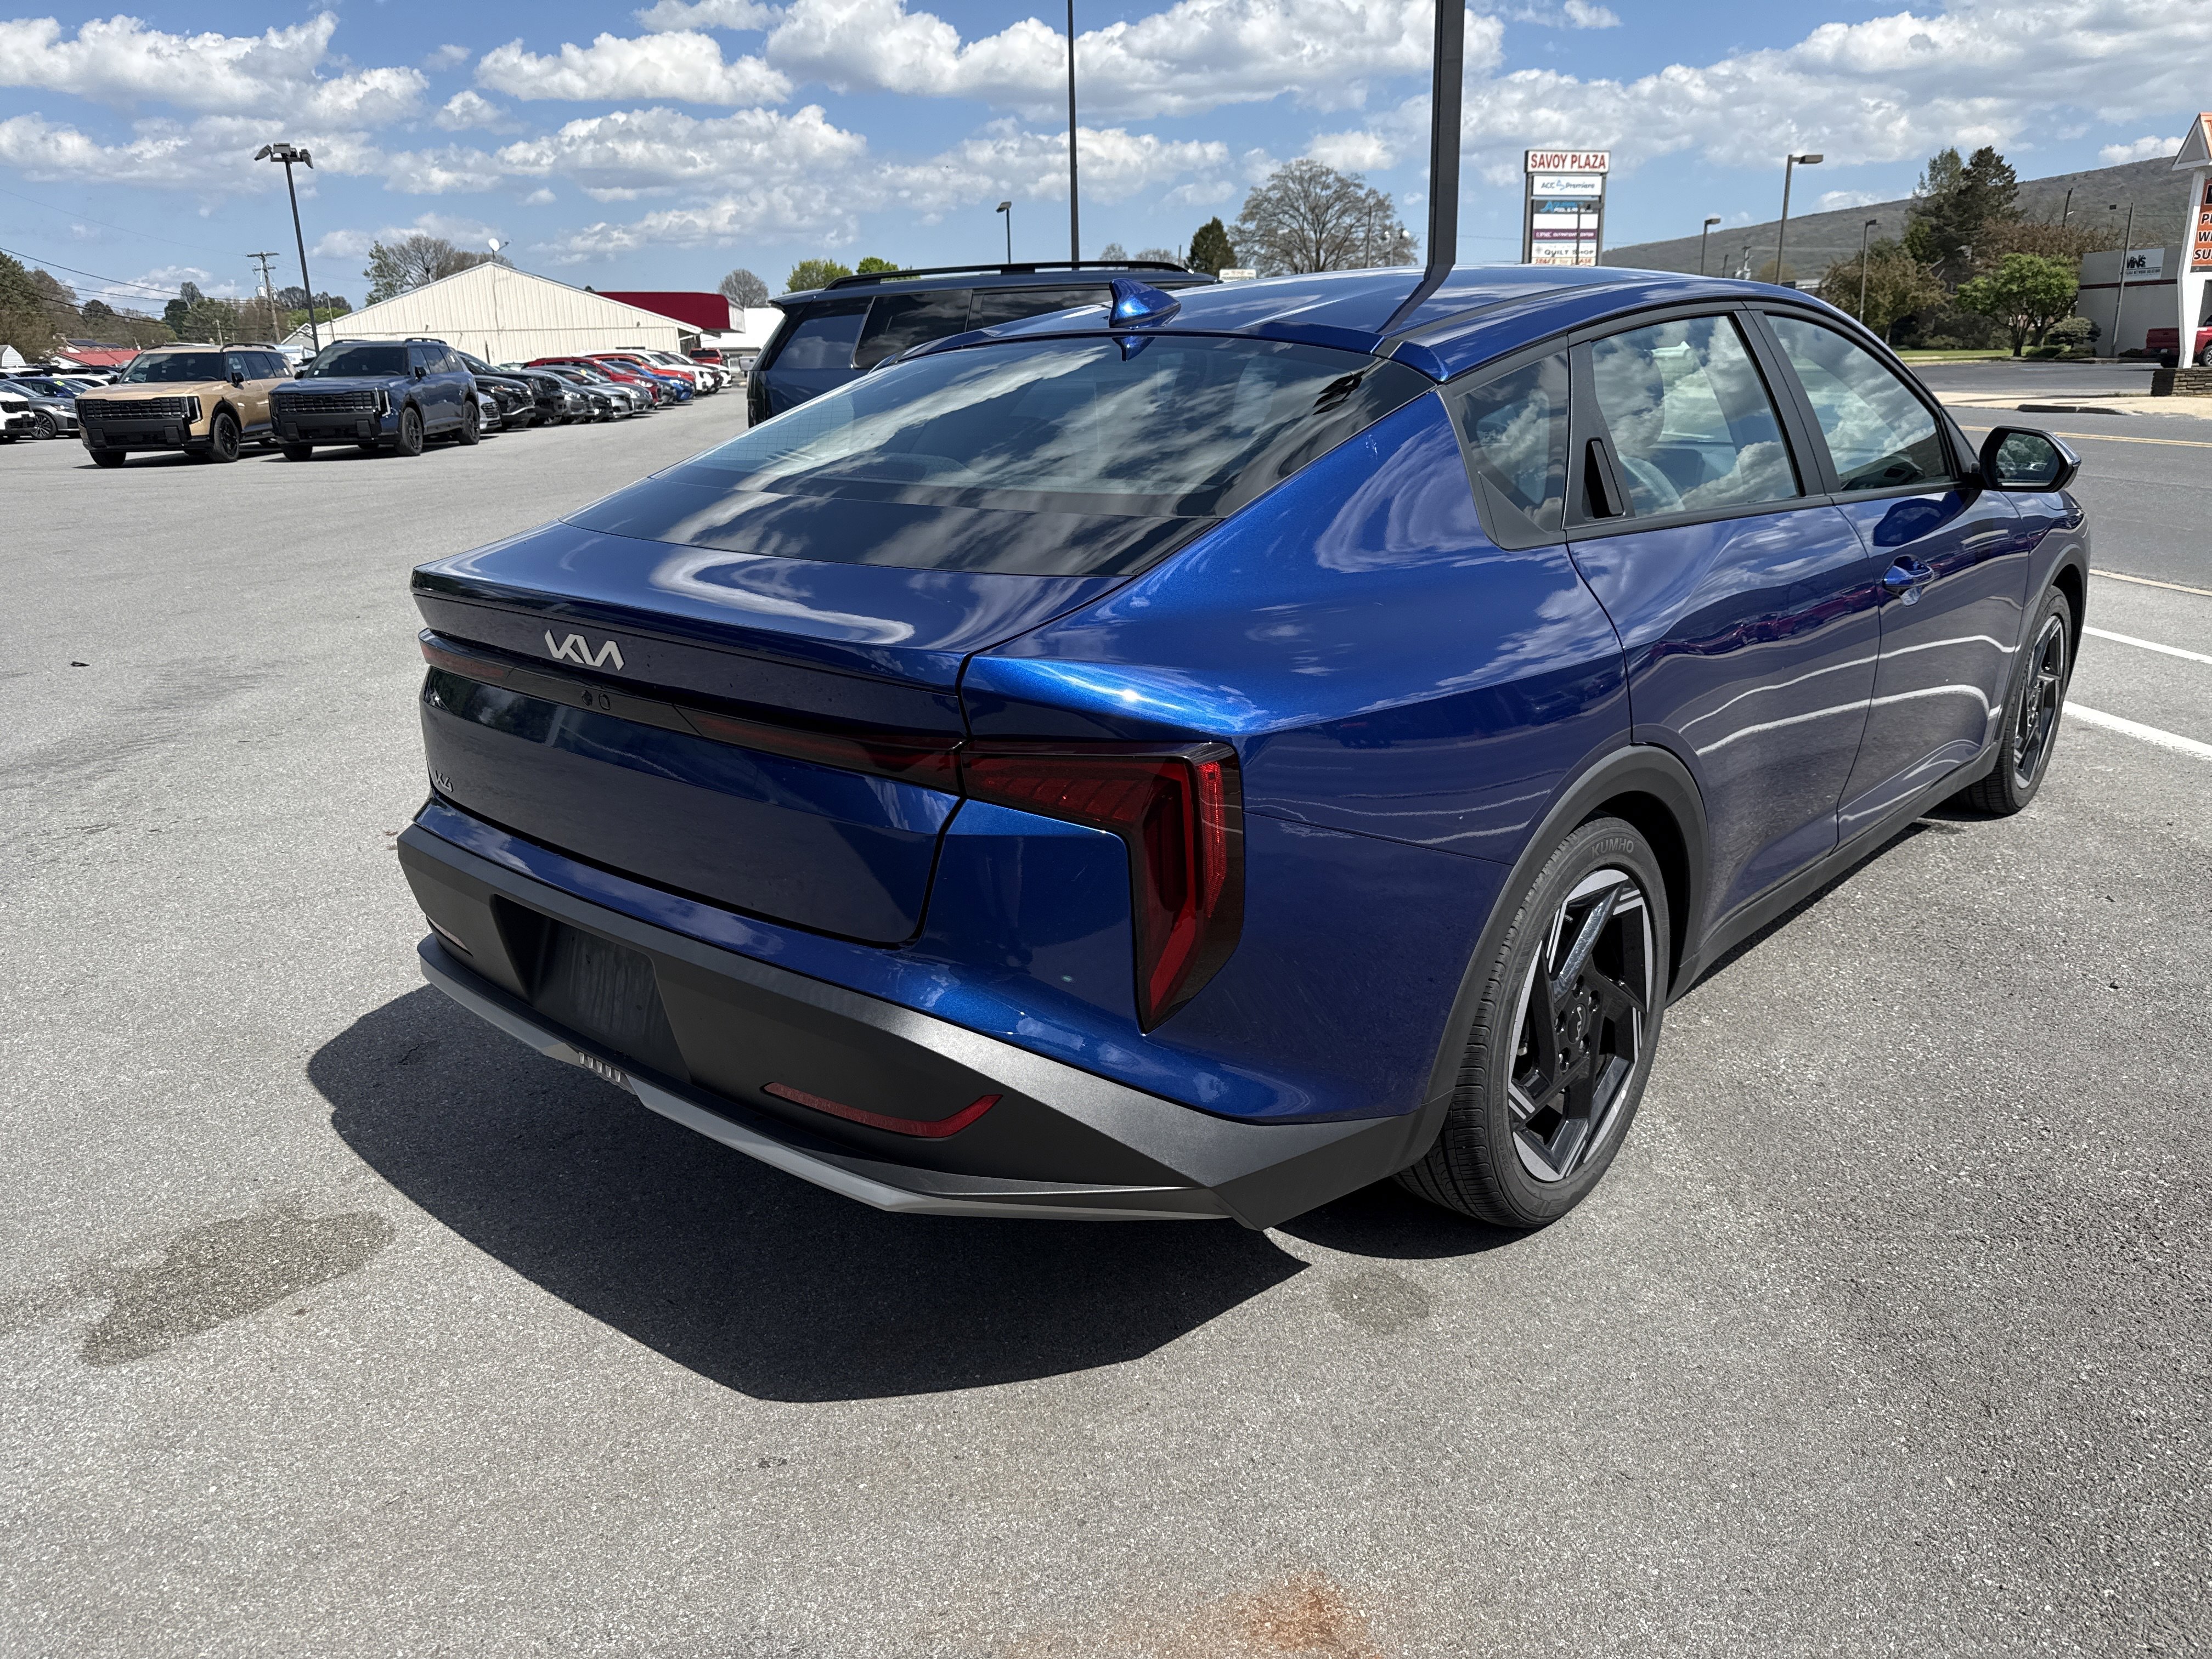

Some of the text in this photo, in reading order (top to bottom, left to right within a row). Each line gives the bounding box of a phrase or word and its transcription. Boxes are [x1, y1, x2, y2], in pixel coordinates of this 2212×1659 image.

[1531, 154, 1606, 169] SAVOY PLAZA
[2194, 249, 2212, 259] SU
[544, 629, 625, 671] KIA
[434, 770, 454, 792] K4
[1591, 838, 1634, 859] KUMHO
